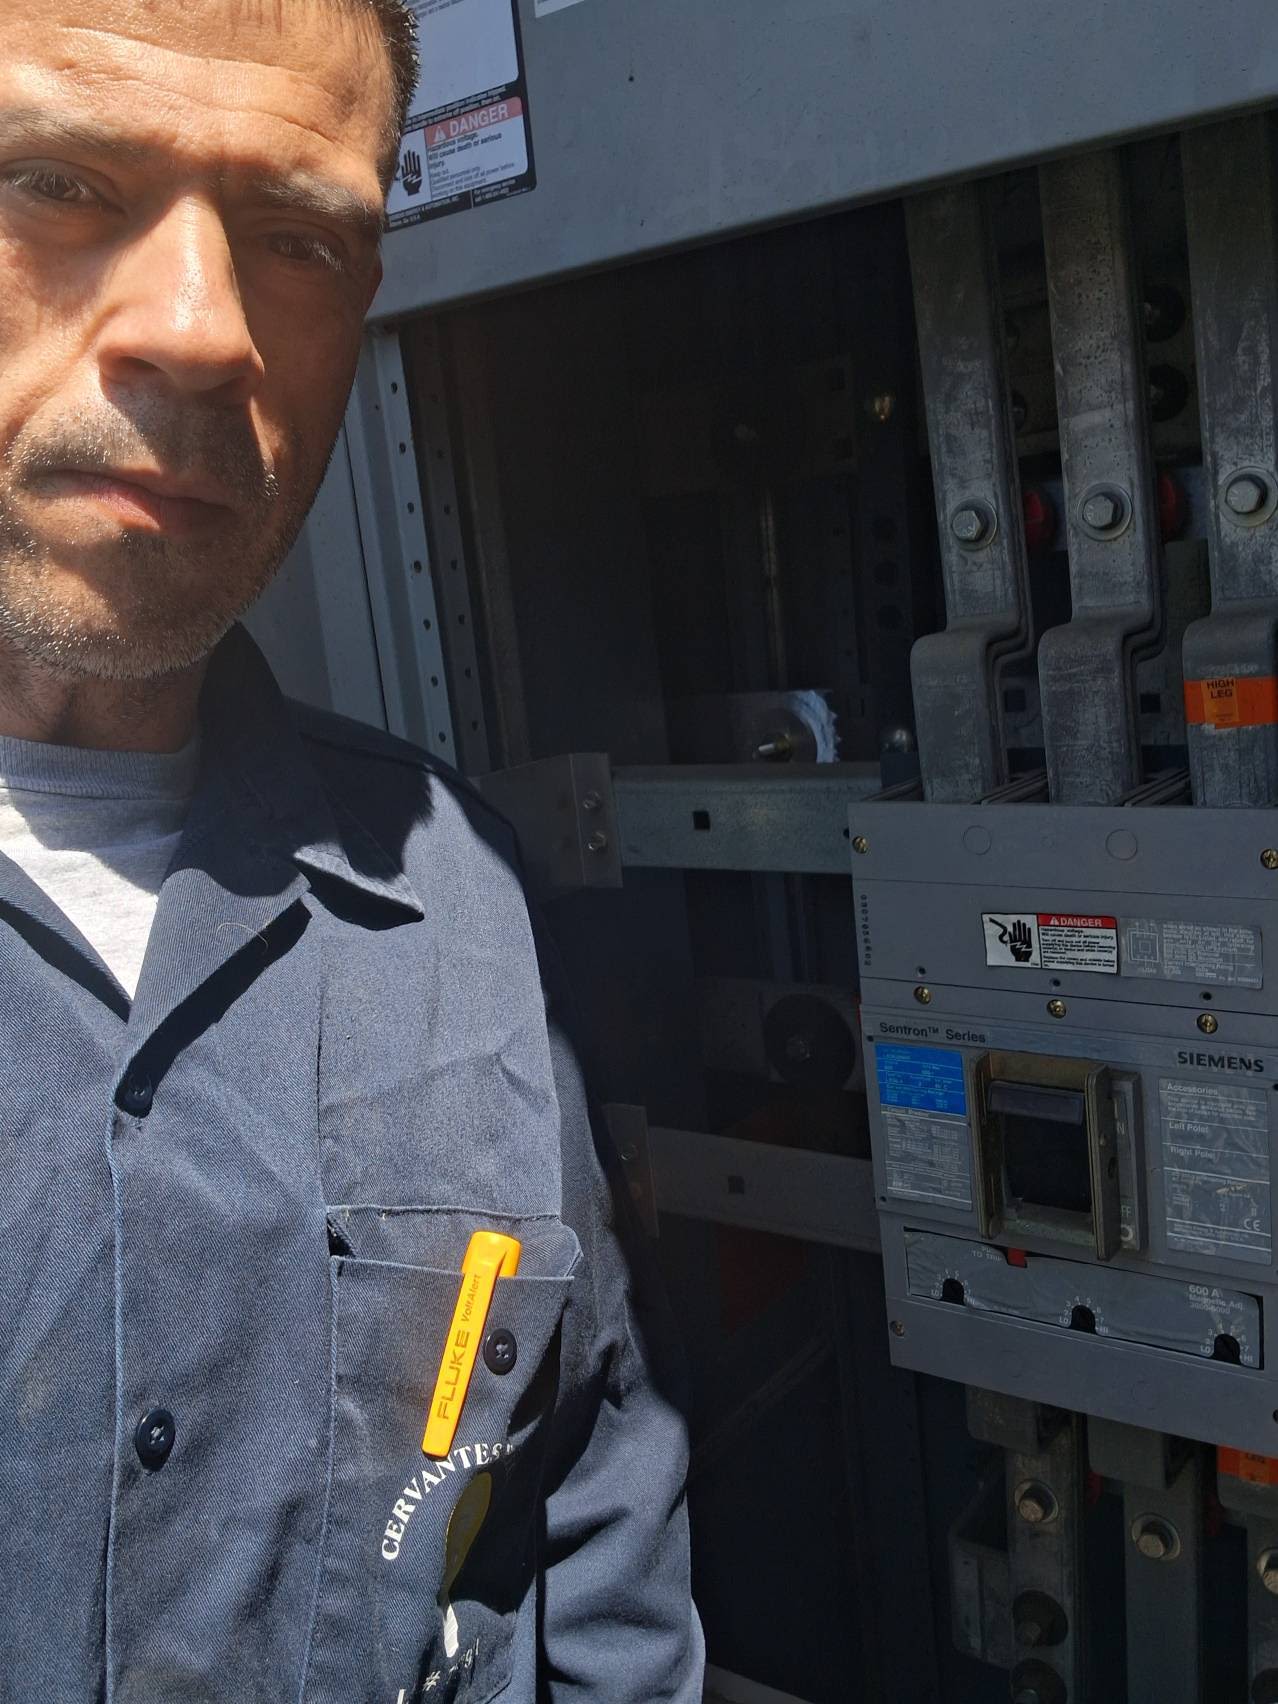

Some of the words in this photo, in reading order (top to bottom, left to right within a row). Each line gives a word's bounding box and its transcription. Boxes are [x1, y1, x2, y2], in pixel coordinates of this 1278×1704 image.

[449, 104, 509, 136] DANGER
[1206, 679, 1234, 689] HIGH
[1210, 689, 1232, 699] LEG
[1060, 917, 1103, 927] DANGER
[945, 1029, 986, 1043] Series
[1178, 1051, 1264, 1072] SIEMENS
[1167, 1083, 1218, 1095] Accessories
[1189, 1285, 1209, 1296] 600
[1211, 1288, 1220, 1298] A
[437, 1329, 470, 1420] FLUKE
